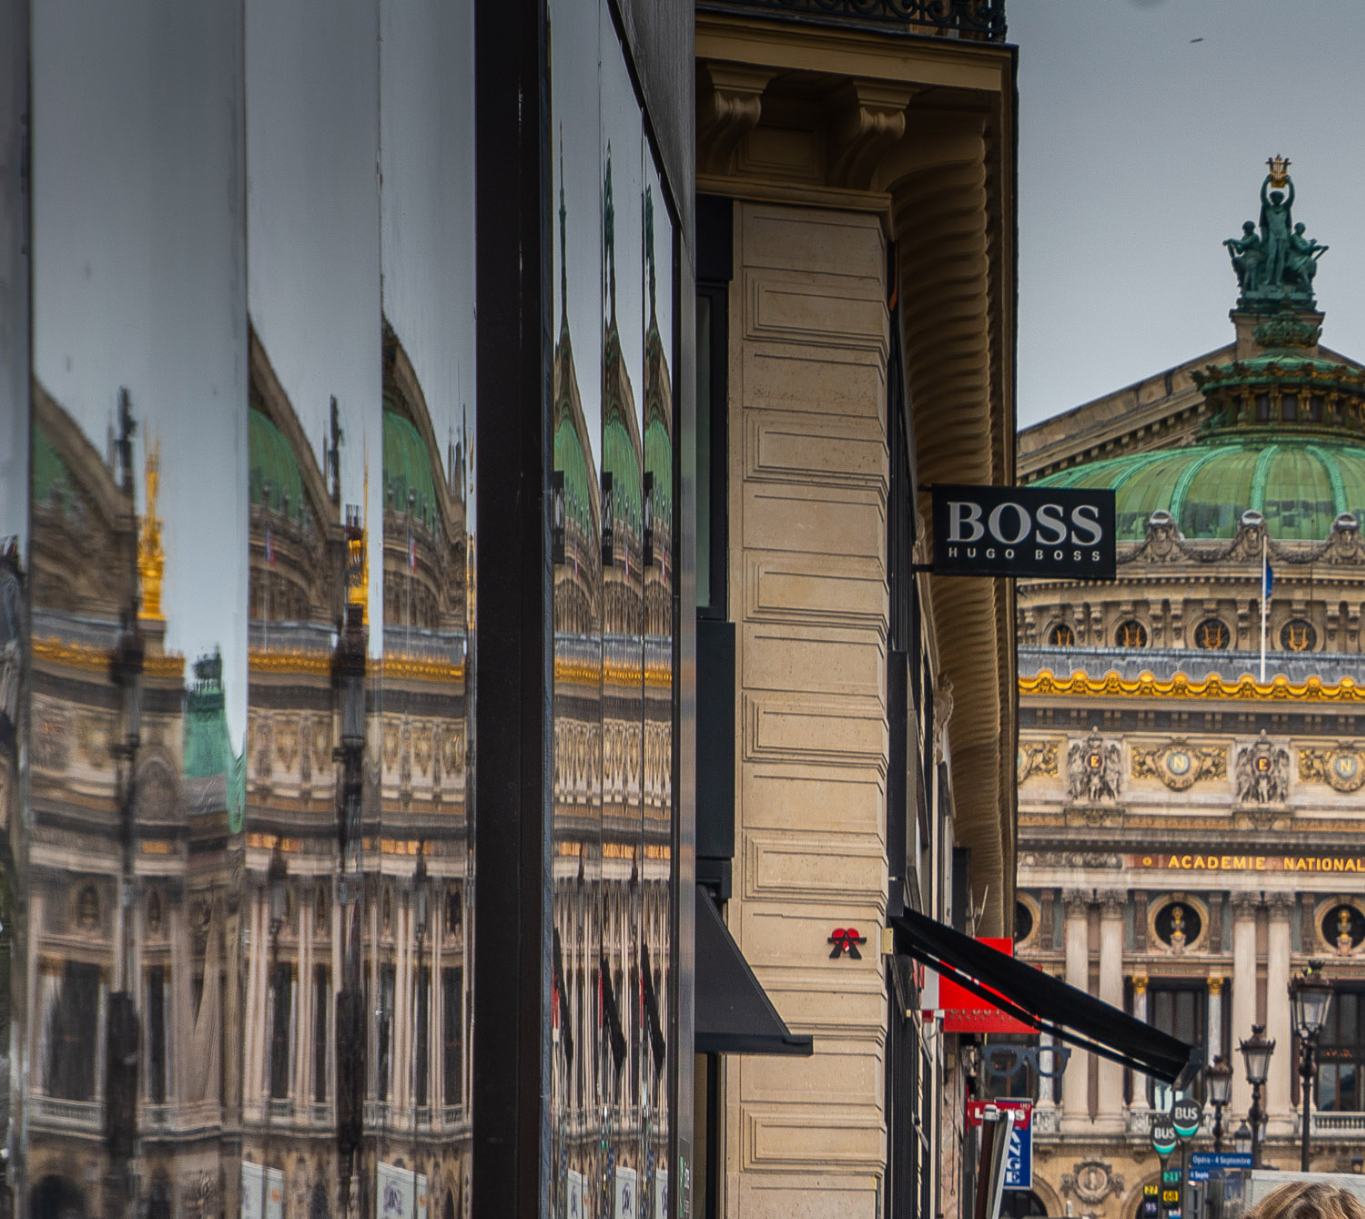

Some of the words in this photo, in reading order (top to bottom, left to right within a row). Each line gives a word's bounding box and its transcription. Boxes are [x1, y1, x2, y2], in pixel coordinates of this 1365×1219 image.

[946, 501, 1103, 546] BOSS
[948, 547, 1015, 560] HUGO
[1034, 549, 1101, 561] BOSS
[1168, 855, 1267, 871] ACADEMIE
[1174, 1106, 1198, 1120] BUS
[1154, 1127, 1175, 1139] BUS
